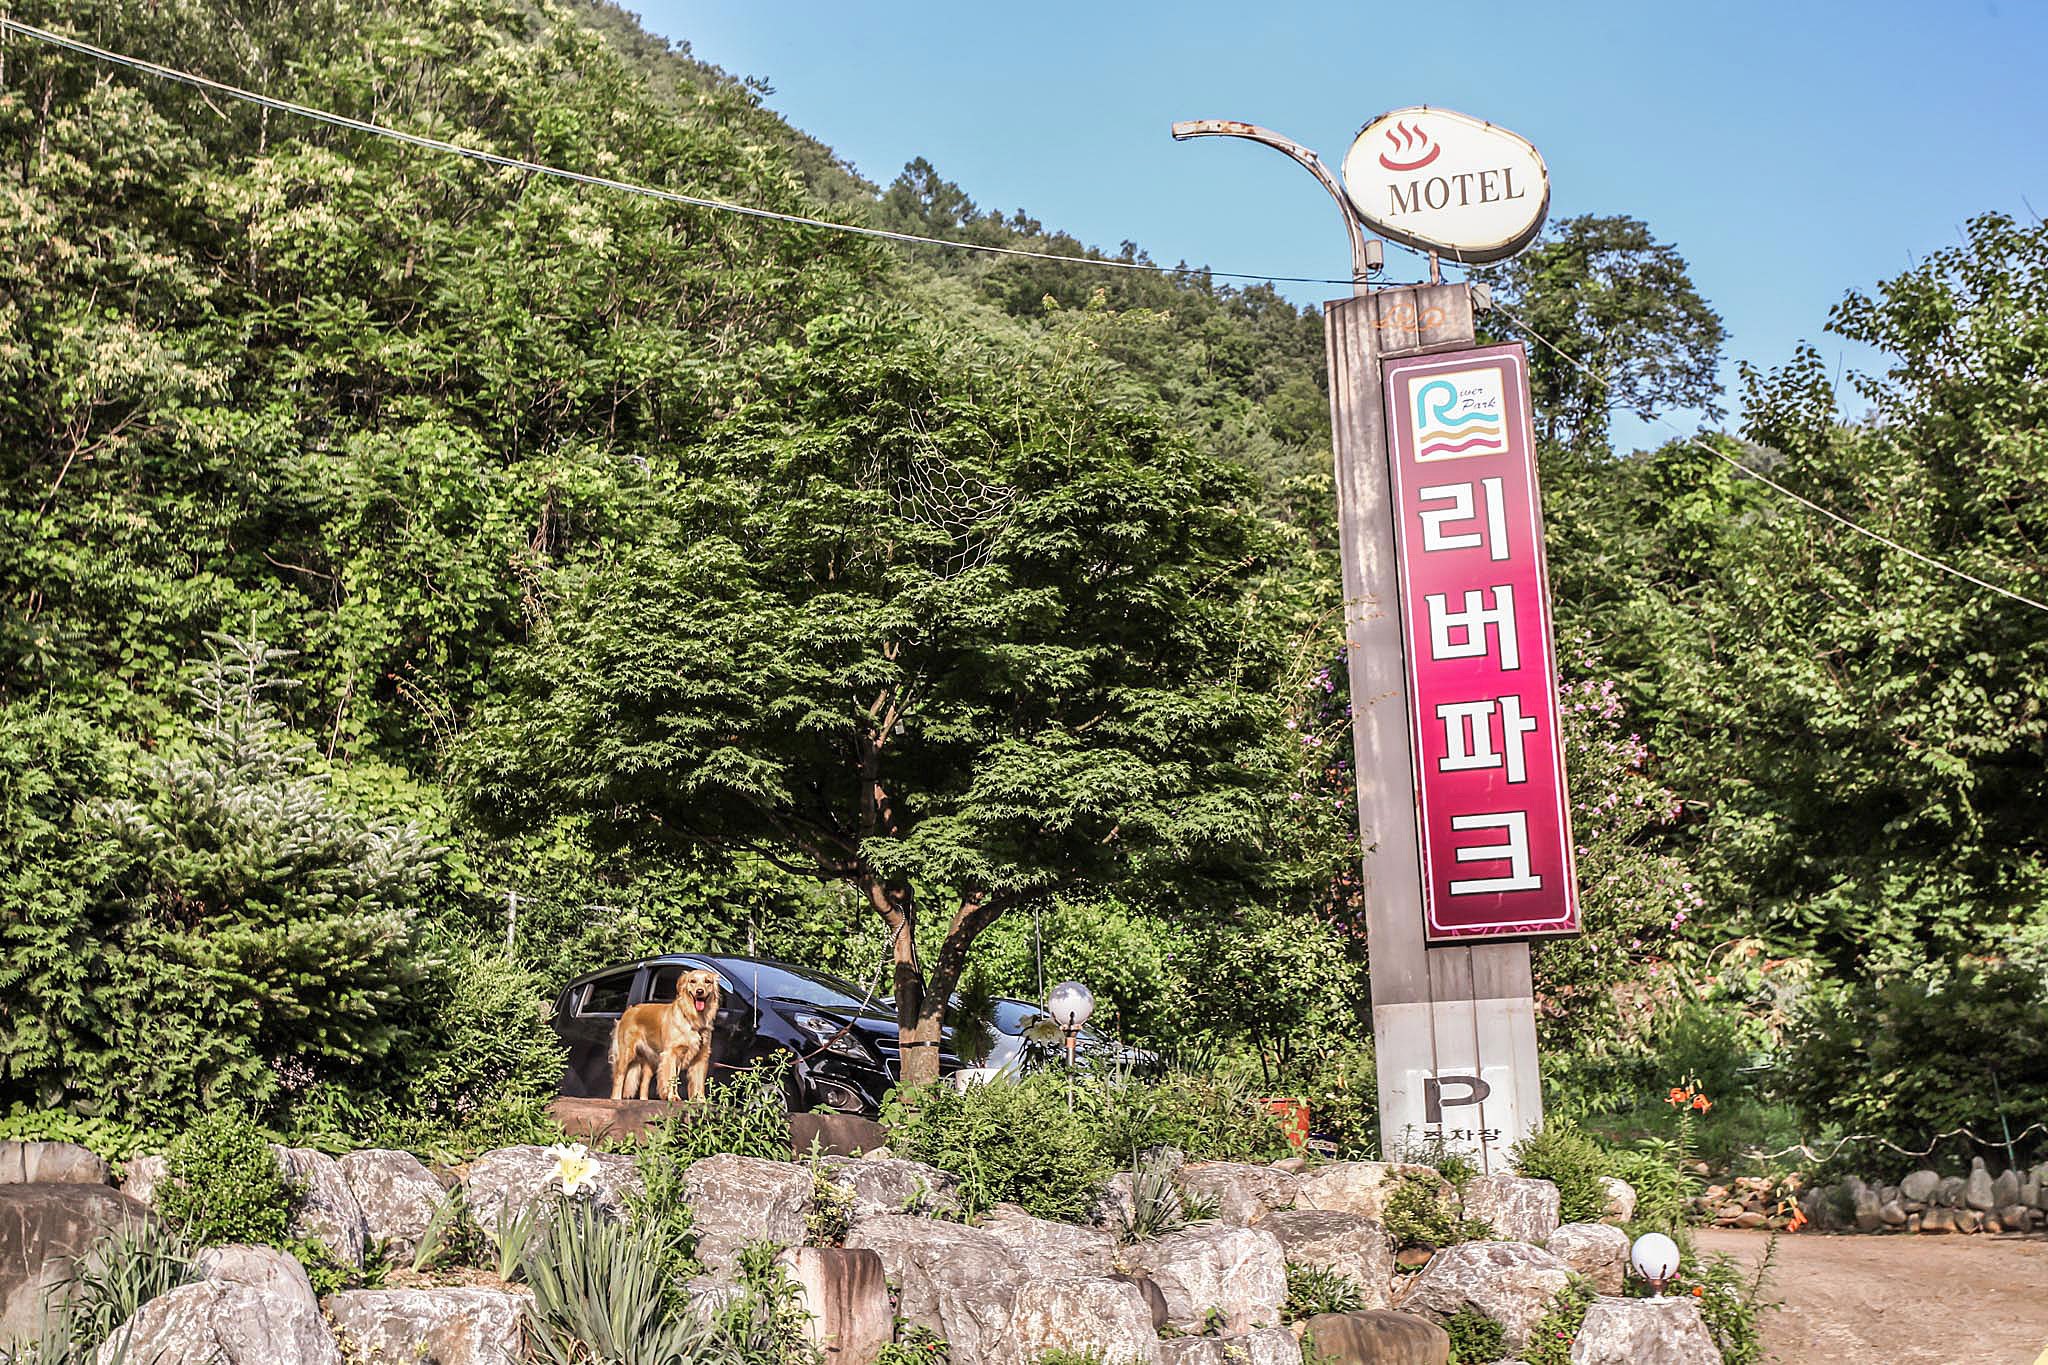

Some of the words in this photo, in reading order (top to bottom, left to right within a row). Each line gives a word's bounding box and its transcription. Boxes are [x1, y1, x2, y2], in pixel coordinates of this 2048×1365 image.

[1387, 167, 1525, 216] MOTEL
[1462, 396, 1497, 411] Park
[1418, 477, 1542, 895] 리버파크
[1423, 1076, 1491, 1124] P
